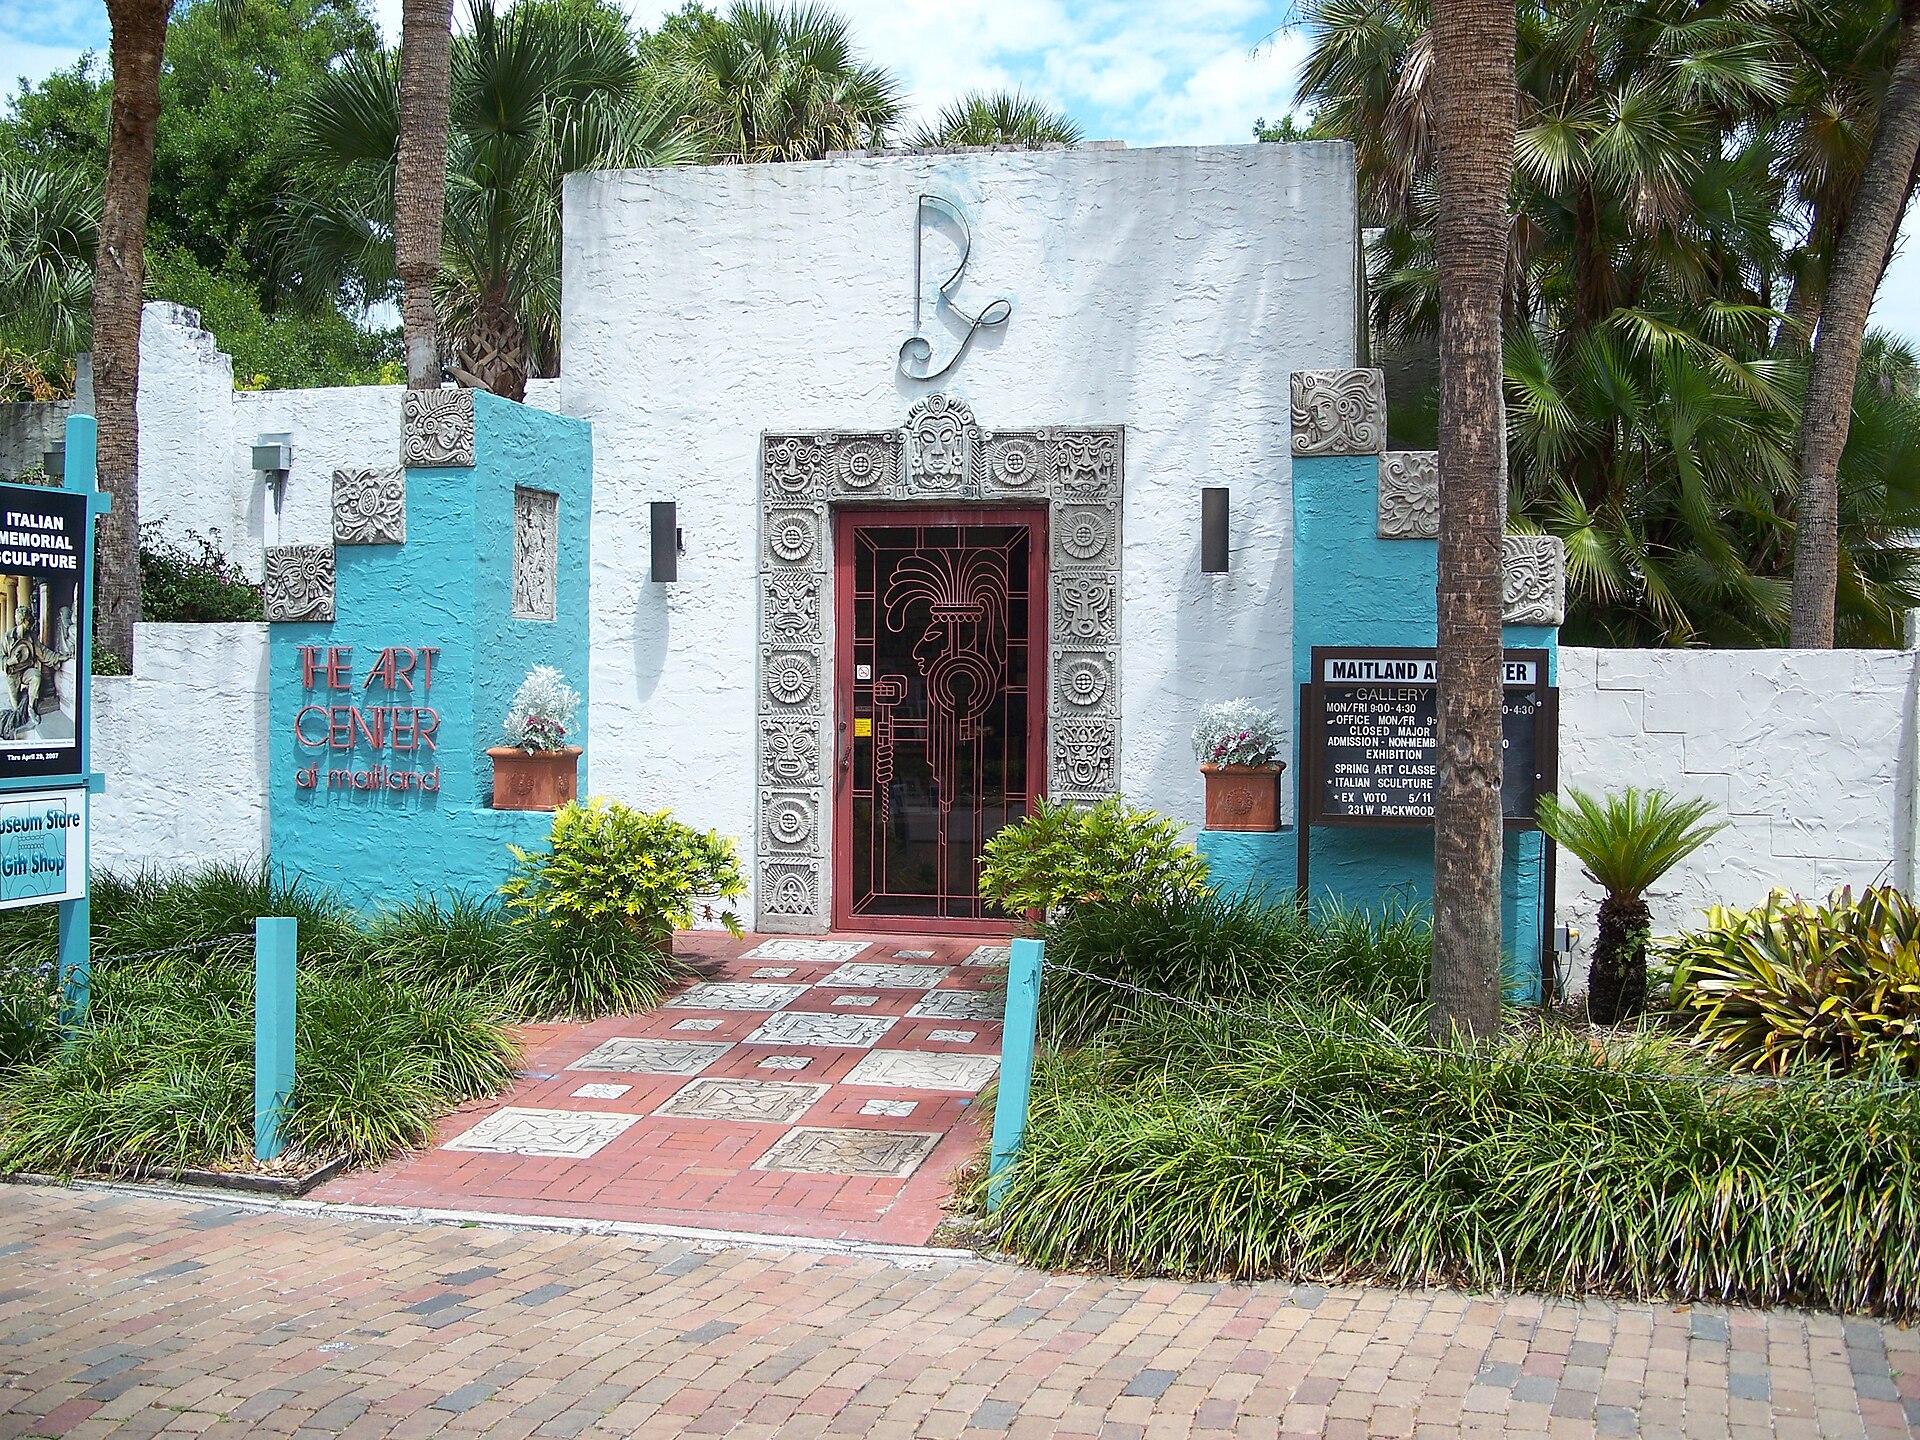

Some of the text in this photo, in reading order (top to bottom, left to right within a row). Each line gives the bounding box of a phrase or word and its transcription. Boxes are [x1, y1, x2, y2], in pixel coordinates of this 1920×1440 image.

[7, 511, 64, 531] ITALIAN
[0, 530, 73, 550] MEMORIAL
[0, 550, 77, 570] CULPTURE
[296, 646, 441, 690] THE ART
[1332, 661, 1418, 680] MAITLAND
[1503, 663, 1527, 681] ER
[1356, 687, 1429, 701] GALLERY
[1326, 702, 1367, 713] MON/FRI
[1336, 714, 1370, 725] OFFICE
[1378, 715, 1415, 726] MON/FR
[294, 705, 441, 751] CENTER
[1349, 726, 1430, 737] CLOSED MAJOR
[1327, 736, 1379, 747] ADMISSION
[21, 753, 35, 762] April
[45, 752, 59, 760] 2007
[1365, 749, 1422, 760] EXHIBITION
[1334, 763, 1436, 775] SPRING ART CLASSE
[294, 762, 440, 792] at maitland
[1335, 777, 1433, 789] ITALIAN SCULPTURE
[1341, 792, 1355, 803] EX
[1362, 792, 1388, 803] VOTO
[1381, 805, 1434, 816] PACKWOOD
[0, 808, 80, 835] useum Store
[2, 852, 65, 877] Gift Shop
